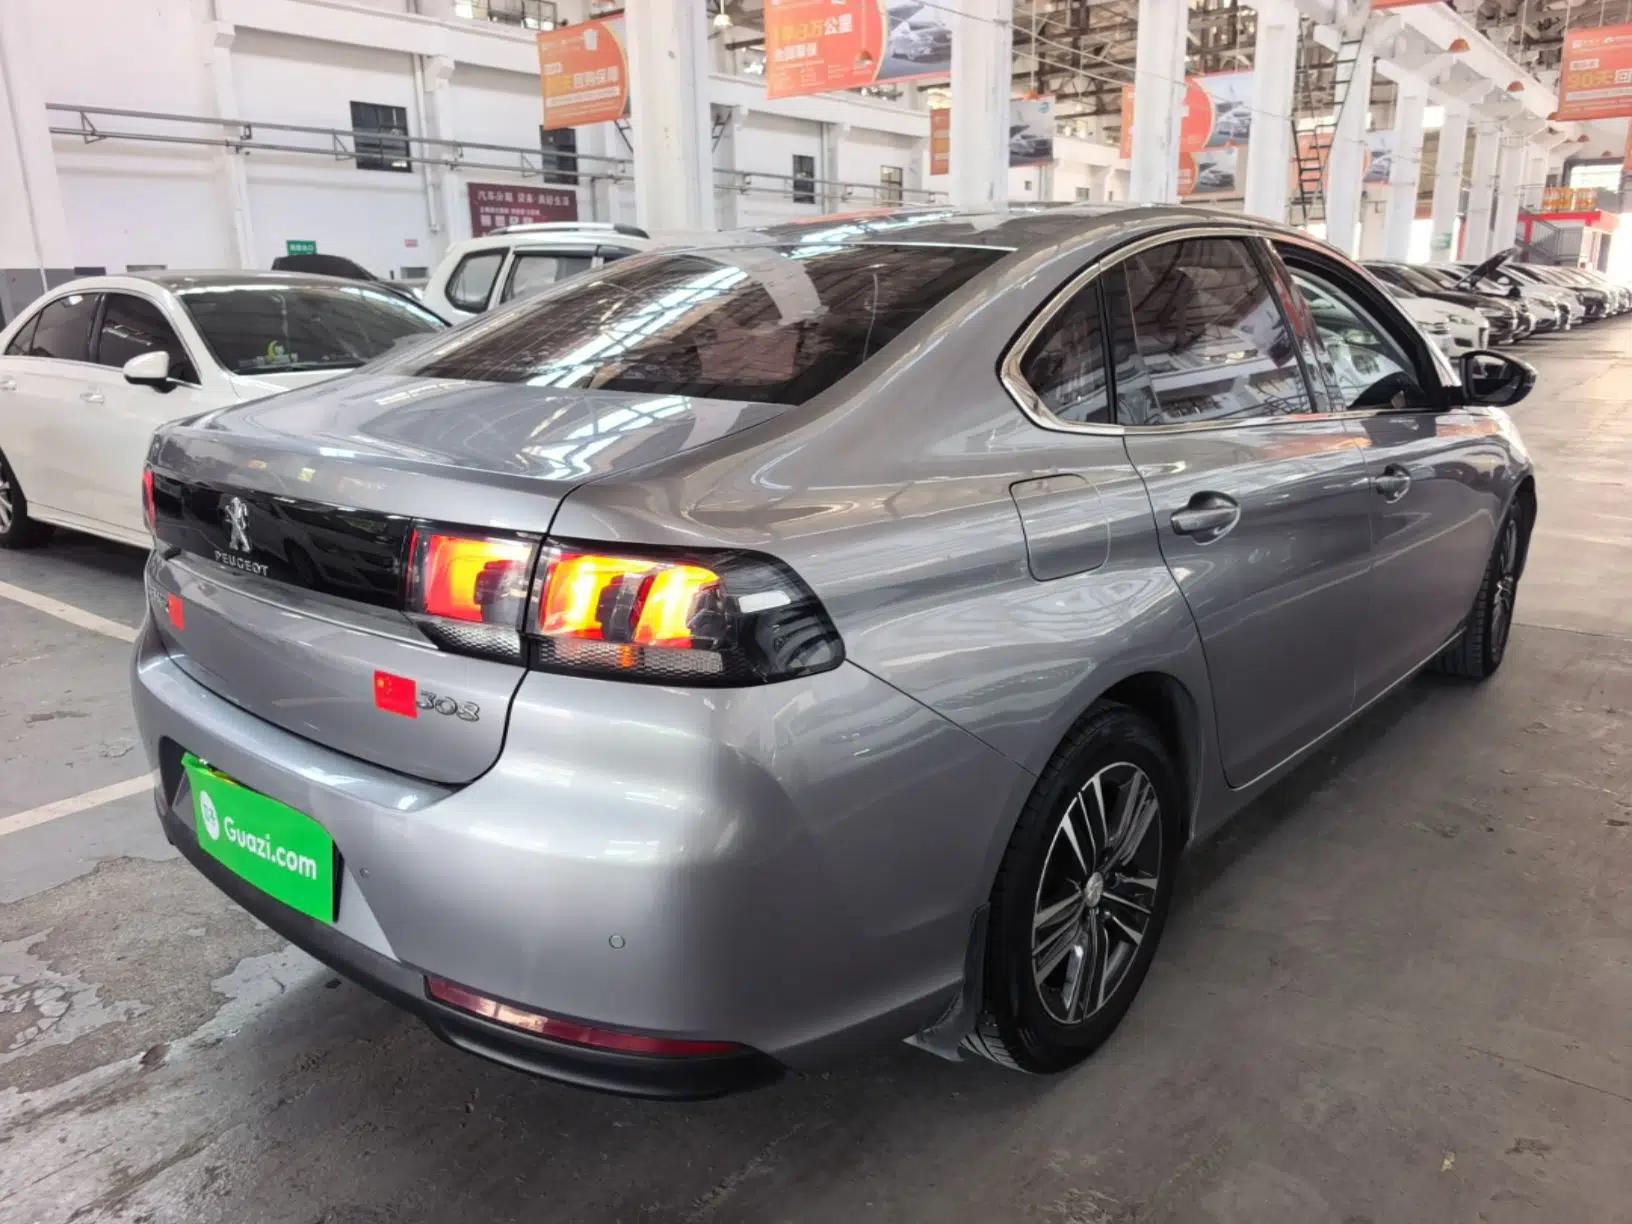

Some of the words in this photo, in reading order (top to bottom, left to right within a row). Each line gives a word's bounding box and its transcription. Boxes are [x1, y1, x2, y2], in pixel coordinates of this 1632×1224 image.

[214, 550, 269, 577] PEUGEOT
[415, 689, 481, 722] 308
[223, 816, 317, 880] Guazi.com
